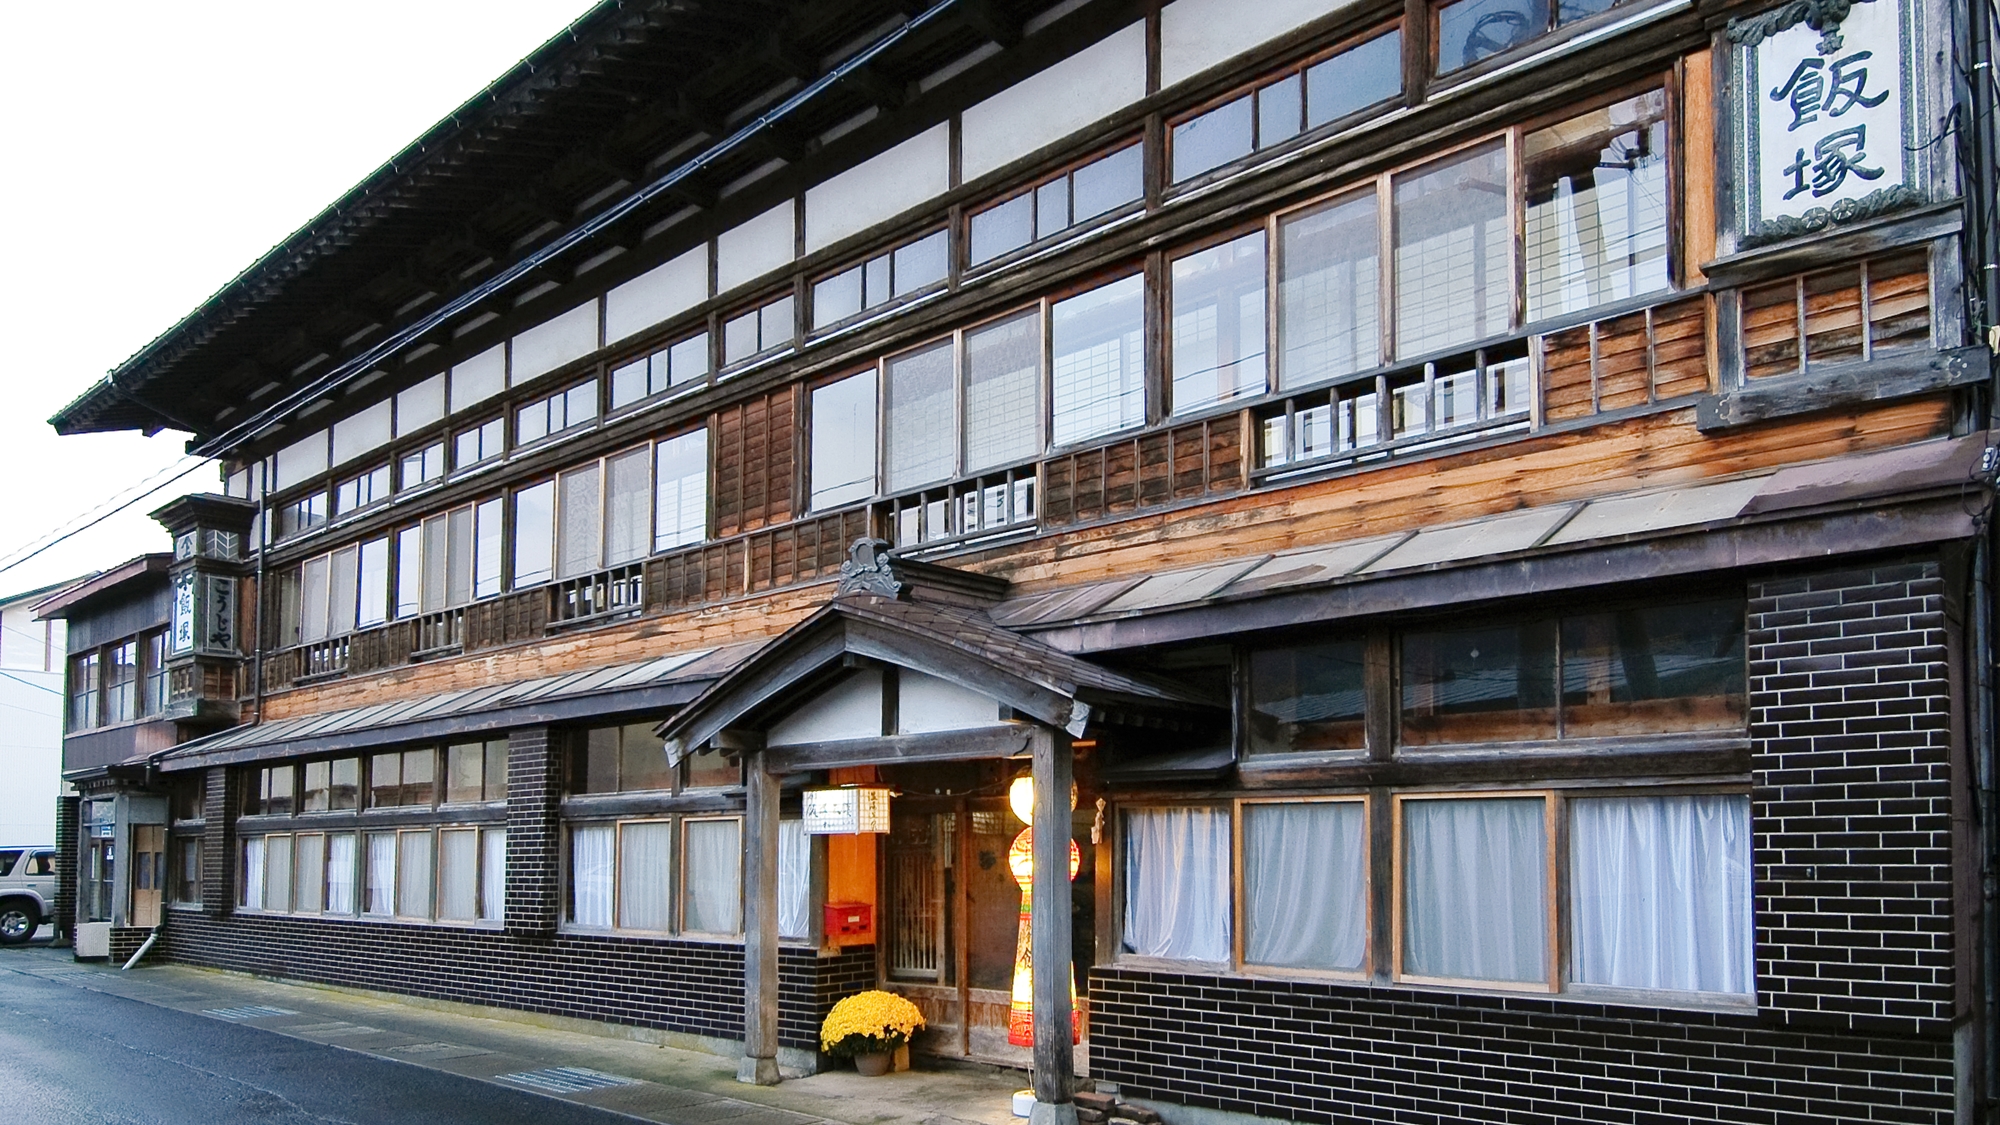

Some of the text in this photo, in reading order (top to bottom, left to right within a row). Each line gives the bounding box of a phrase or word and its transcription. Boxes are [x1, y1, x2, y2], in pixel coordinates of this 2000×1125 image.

[1769, 50, 1890, 201] 飯塚
[210, 579, 231, 649] こうじや
